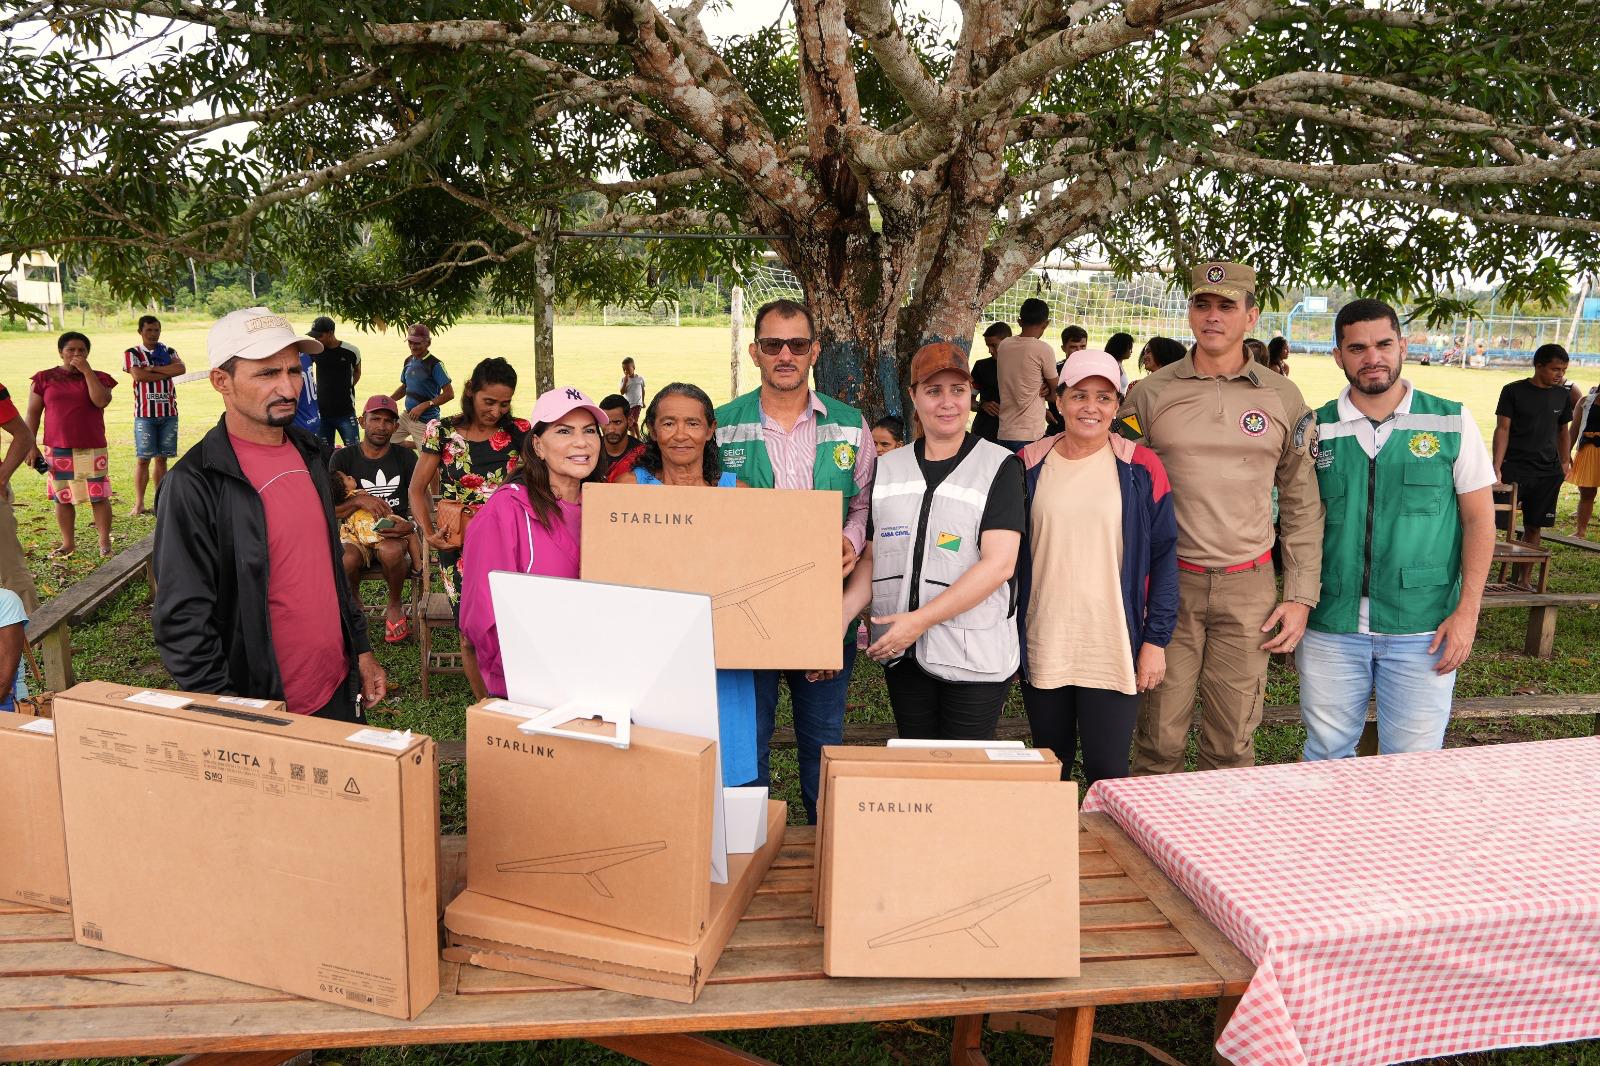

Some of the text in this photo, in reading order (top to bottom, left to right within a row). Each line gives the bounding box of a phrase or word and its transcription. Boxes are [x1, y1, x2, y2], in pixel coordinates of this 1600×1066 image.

[723, 449, 745, 457] SEICT
[1317, 449, 1333, 457] EICT
[610, 511, 694, 525] STARLINK
[486, 735, 555, 759] STARLINK
[217, 750, 260, 768] ZICTA
[858, 801, 934, 813] STARLINK
